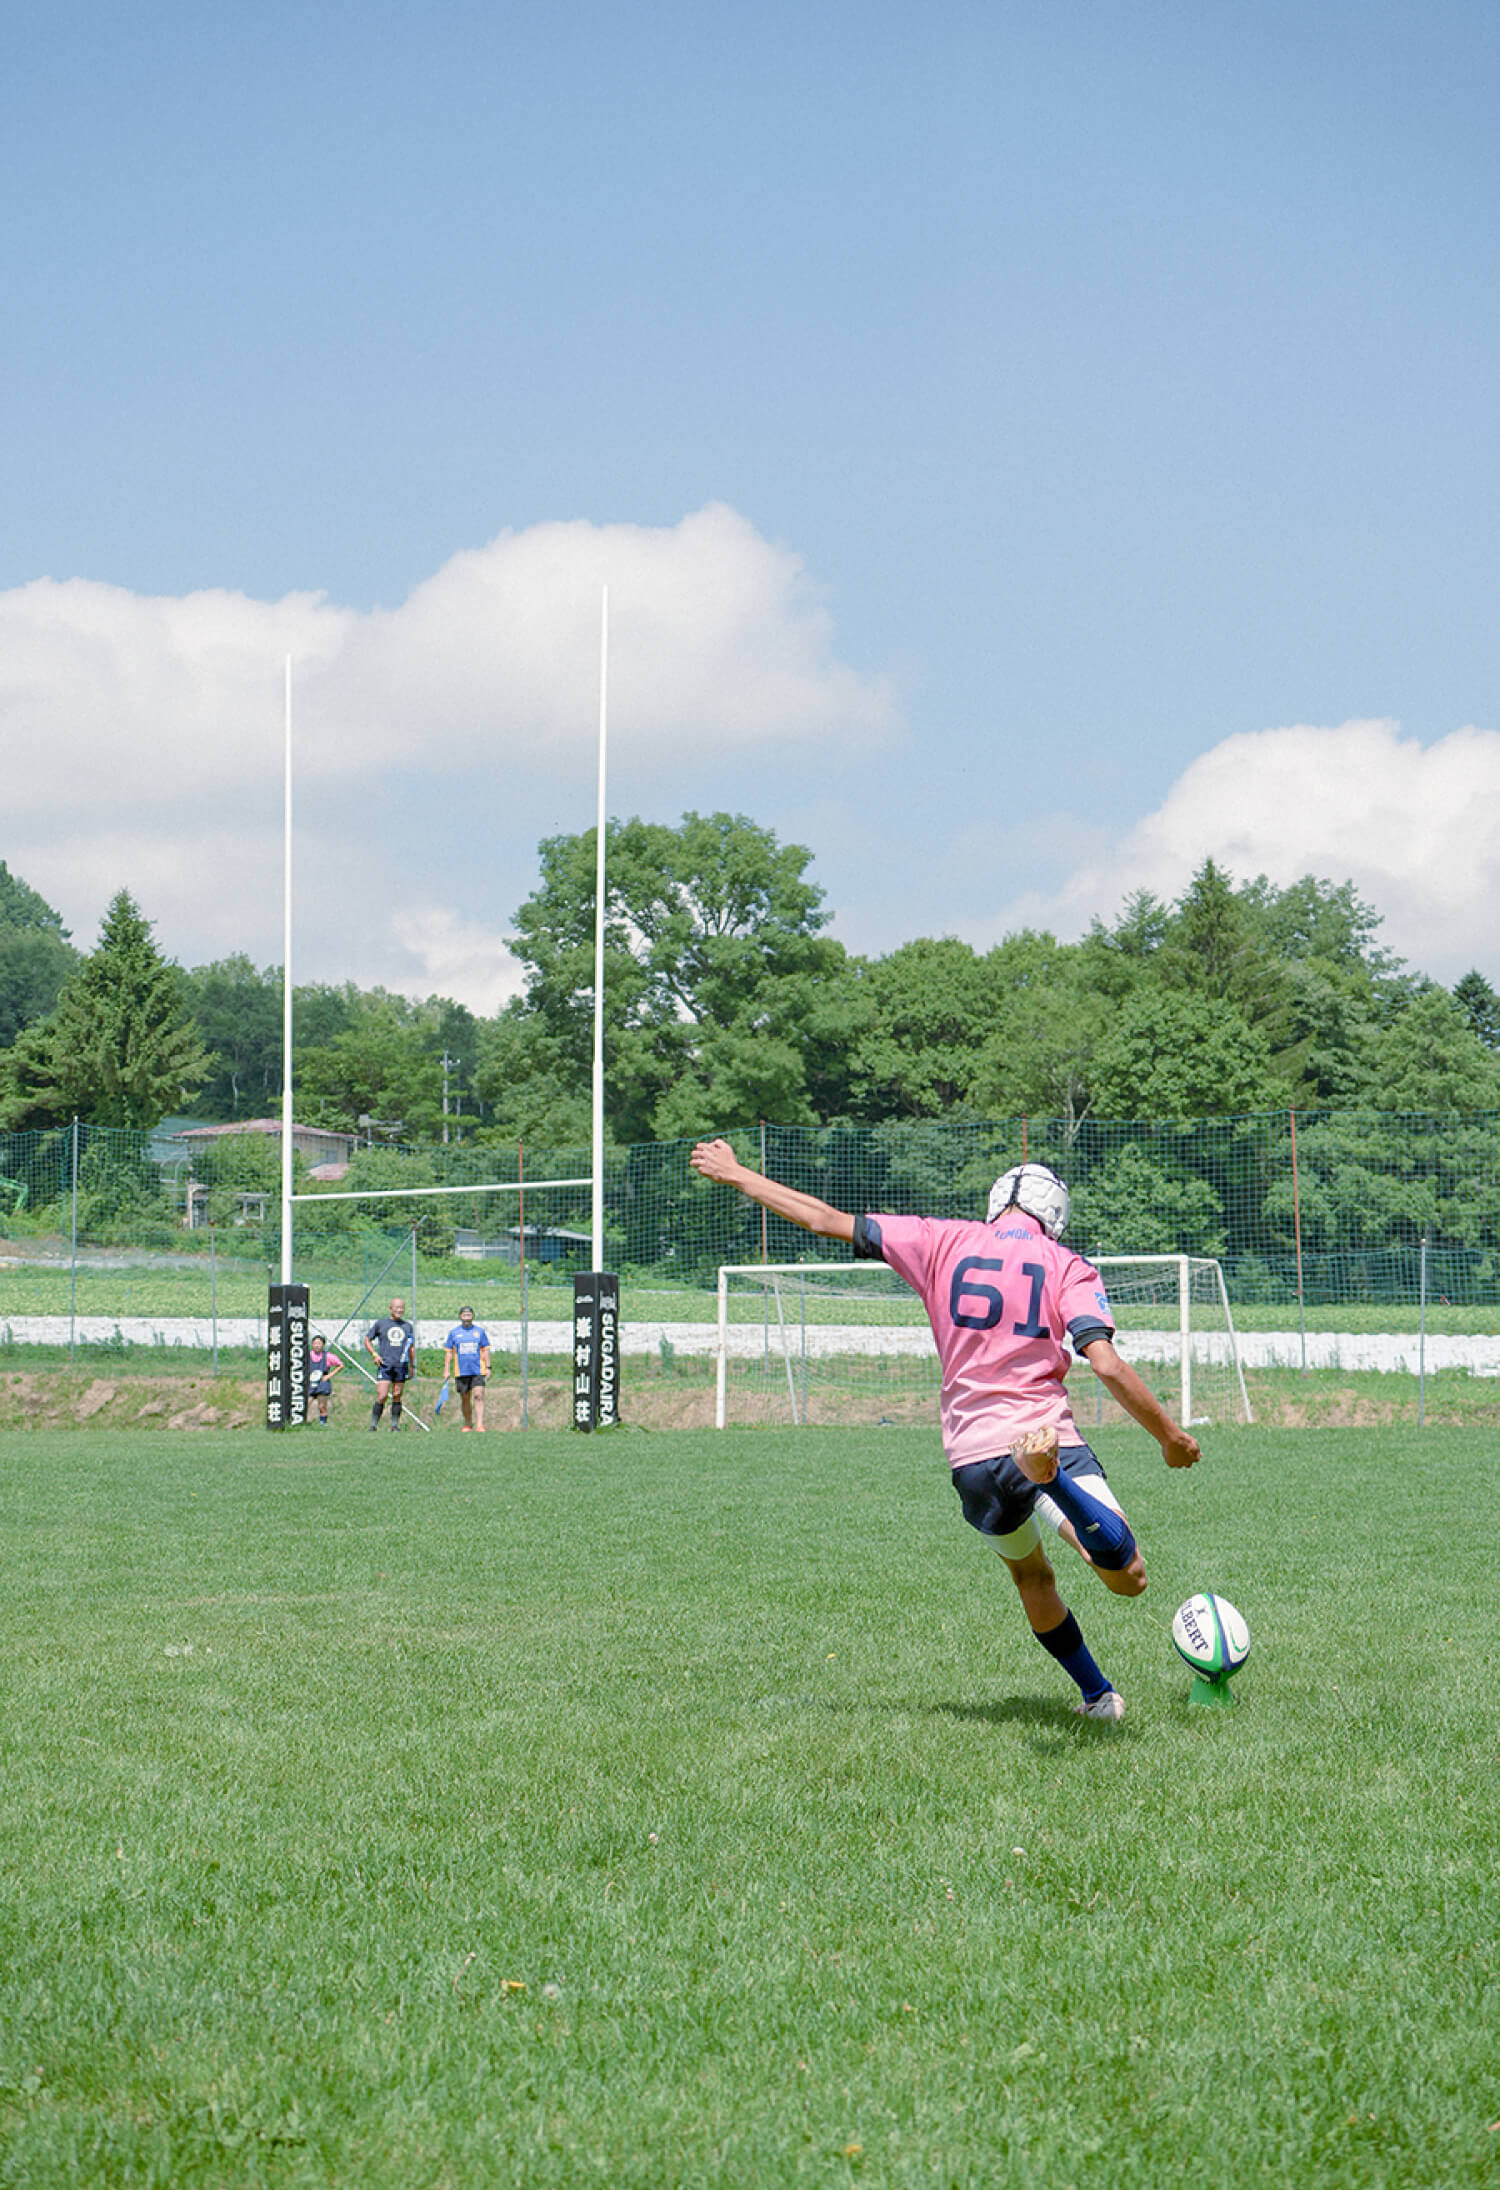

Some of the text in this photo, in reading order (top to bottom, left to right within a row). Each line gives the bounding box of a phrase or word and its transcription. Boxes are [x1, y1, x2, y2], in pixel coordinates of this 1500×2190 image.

[950, 1256, 1050, 1338] 61
[290, 1321, 304, 1425] SUGADAIRA
[600, 1313, 615, 1426] SUGADAIRA
